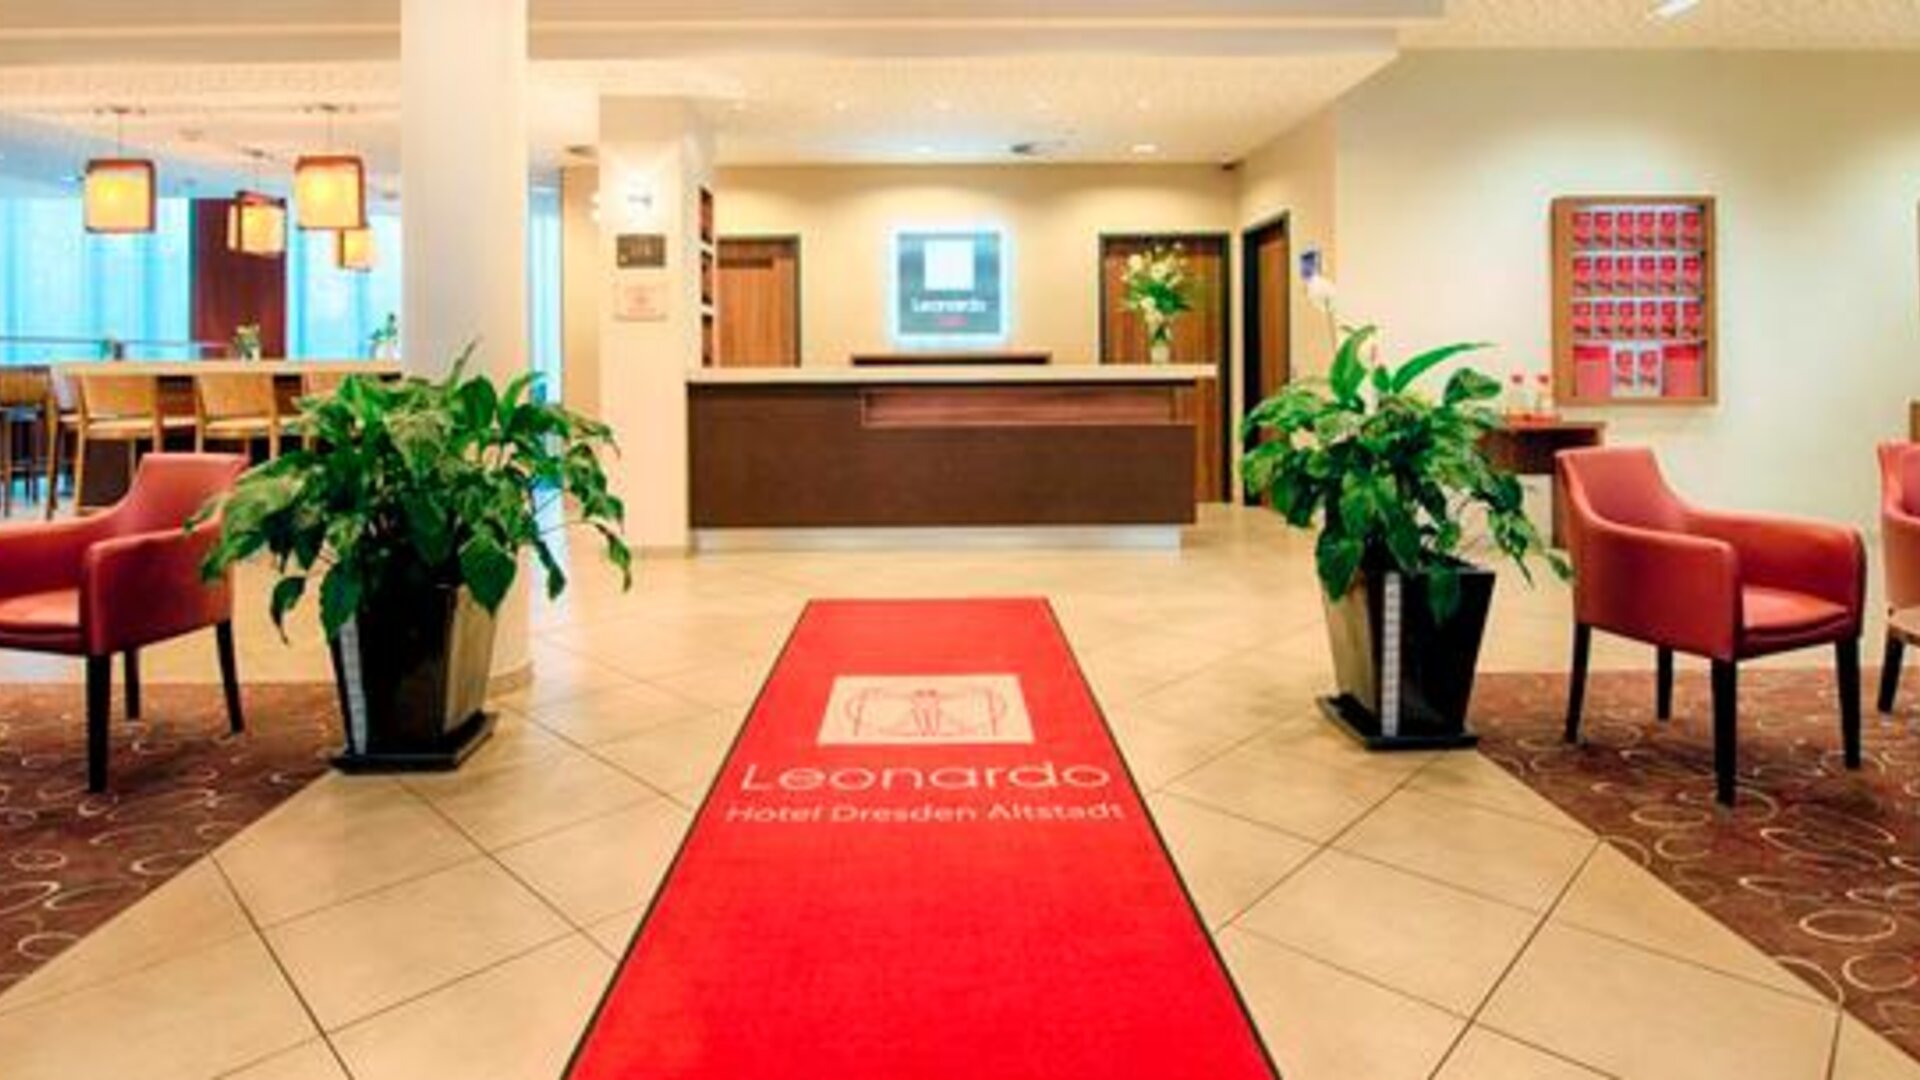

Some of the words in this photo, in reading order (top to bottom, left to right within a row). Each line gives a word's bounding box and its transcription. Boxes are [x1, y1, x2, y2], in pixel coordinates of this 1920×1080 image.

[740, 761, 1111, 791] Leonardo
[725, 804, 821, 823] Hotel
[832, 803, 976, 822] Dresden
[987, 802, 1124, 820] Altstadt
